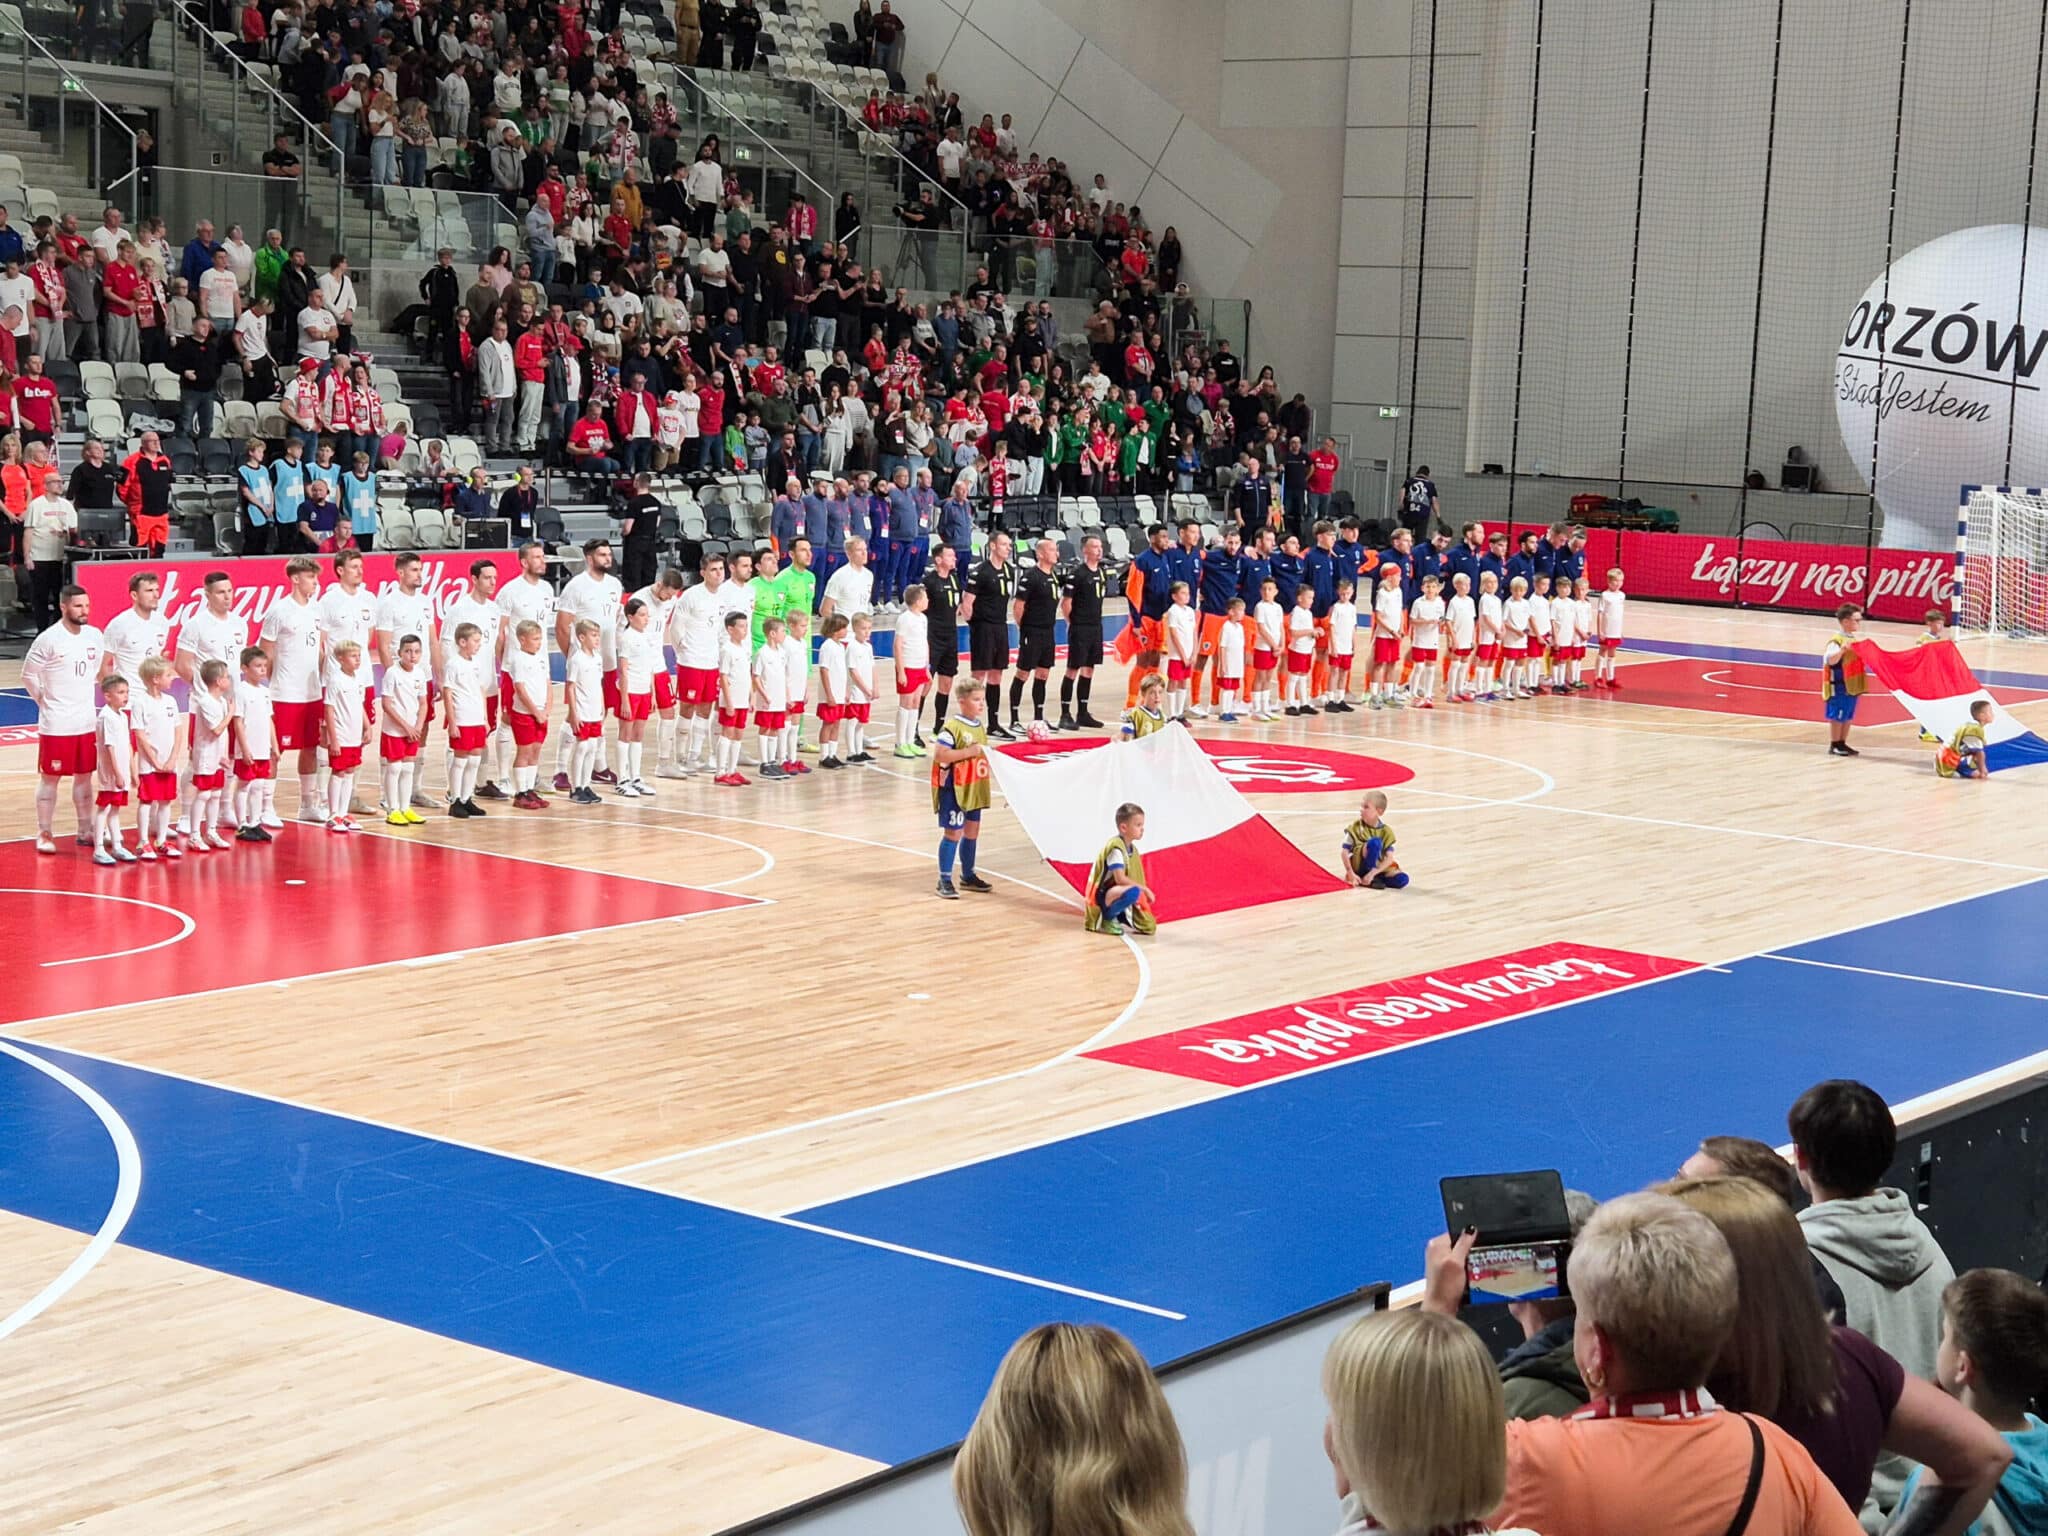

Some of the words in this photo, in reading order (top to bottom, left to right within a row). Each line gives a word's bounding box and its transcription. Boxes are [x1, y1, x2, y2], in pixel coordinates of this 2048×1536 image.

[1835, 363, 1991, 423] StądJestem
[1691, 543, 1799, 605] Łączy
[1800, 563, 1868, 598] nas
[74, 660, 87, 677] 10
[976, 759, 989, 778] 6
[948, 810, 965, 826] 30
[1425, 958, 1637, 1002] Łączy
[1347, 992, 1469, 1027] nas
[1179, 1006, 1369, 1063] piłka
